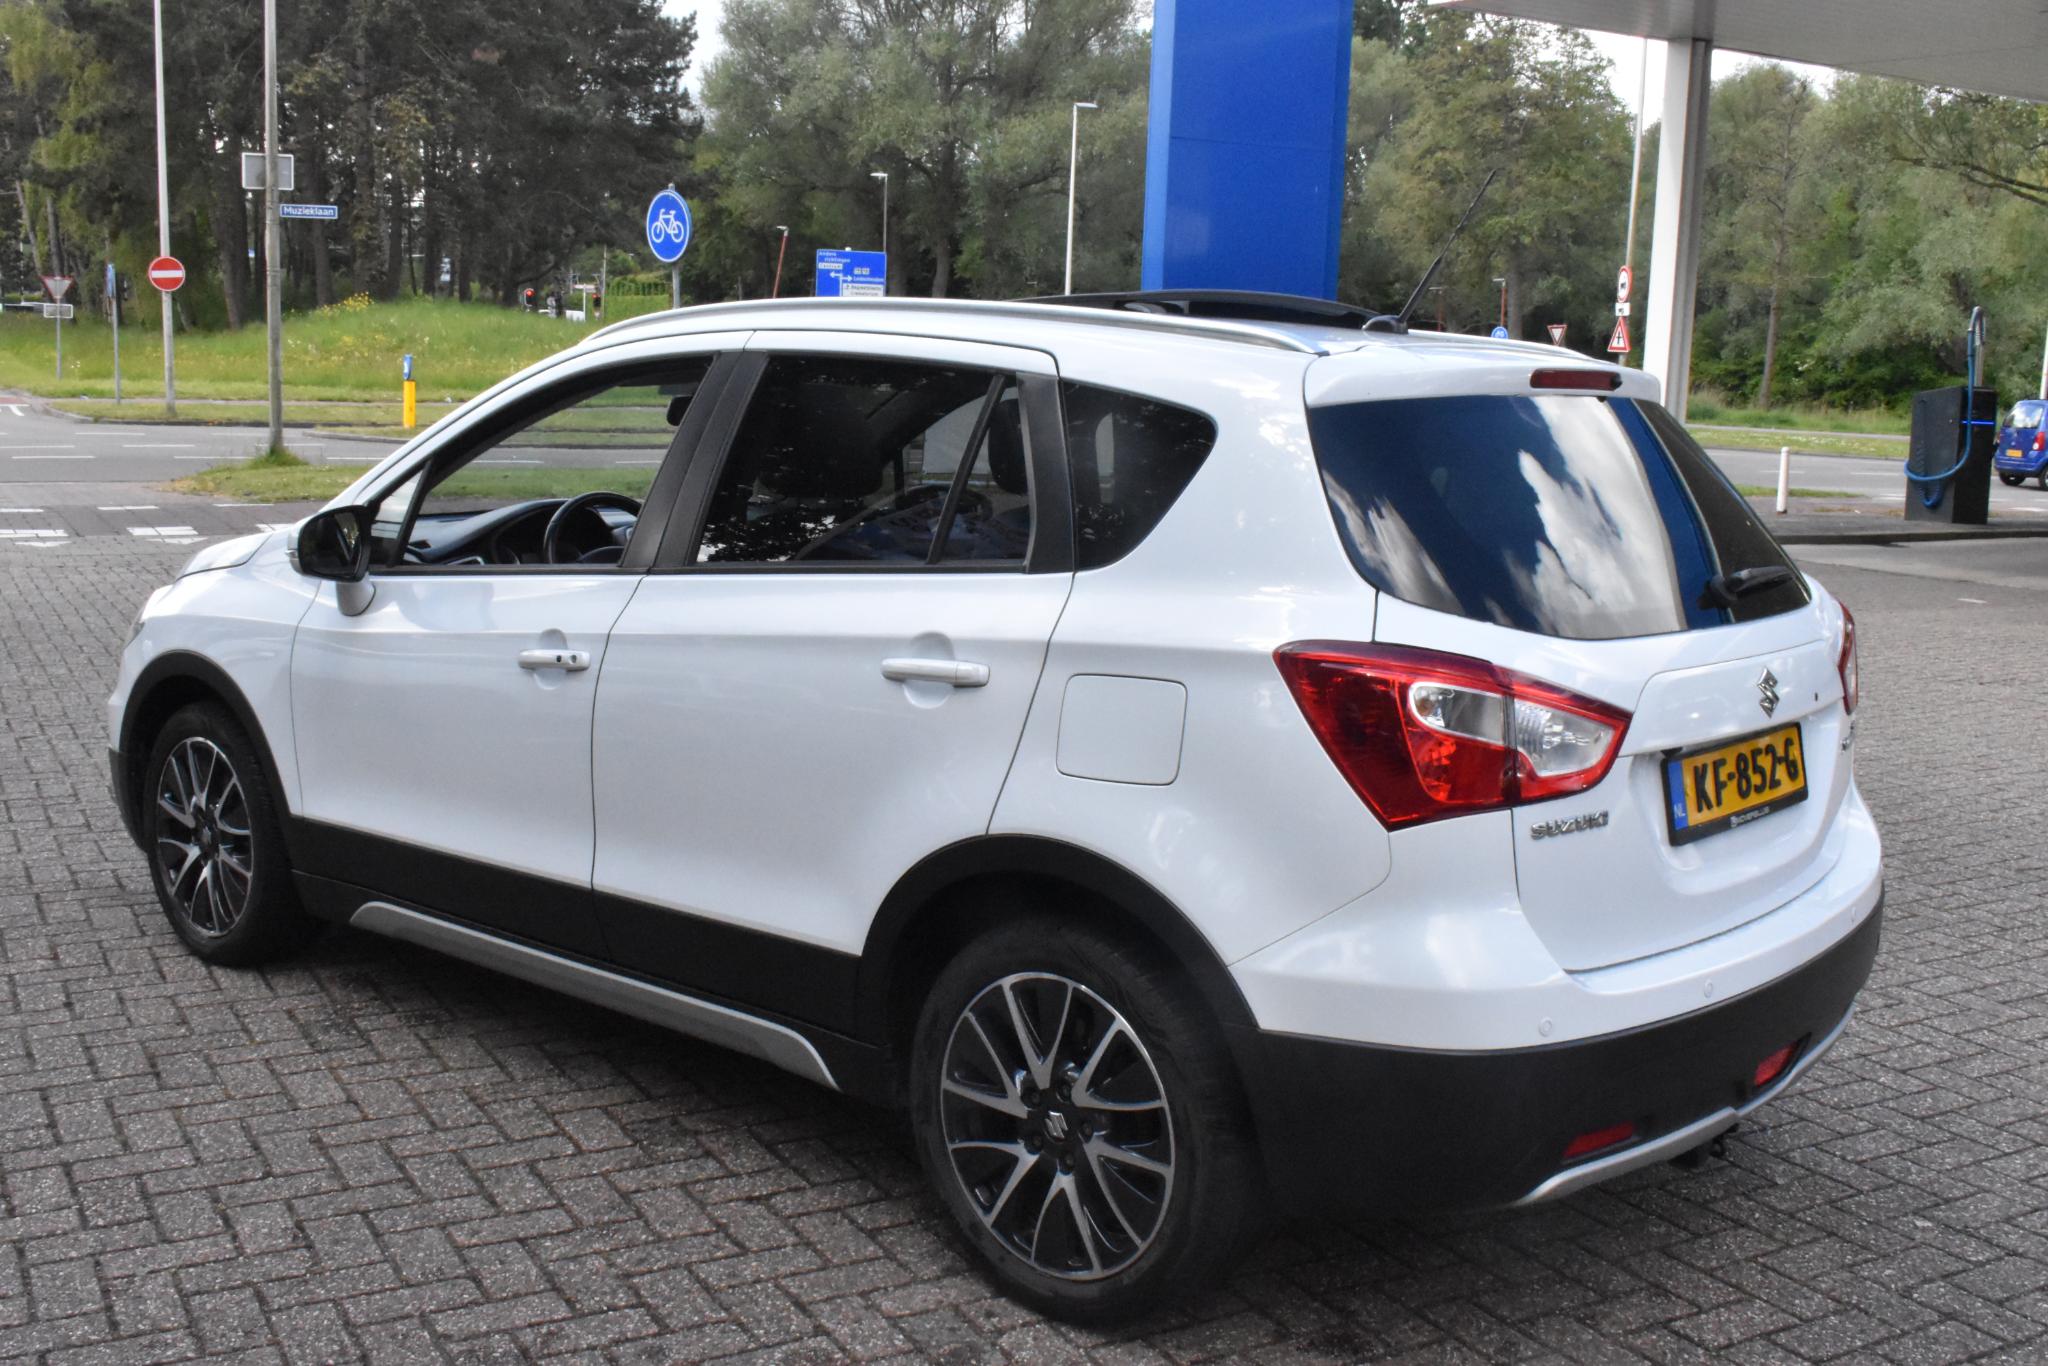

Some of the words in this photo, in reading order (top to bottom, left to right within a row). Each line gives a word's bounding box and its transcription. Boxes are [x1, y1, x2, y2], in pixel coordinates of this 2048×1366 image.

[283, 206, 335, 216] Muzieklaan
[1694, 738, 1799, 813] KF-852-G
[1673, 803, 1686, 818] NL
[1531, 809, 1609, 840] SUZUKI
